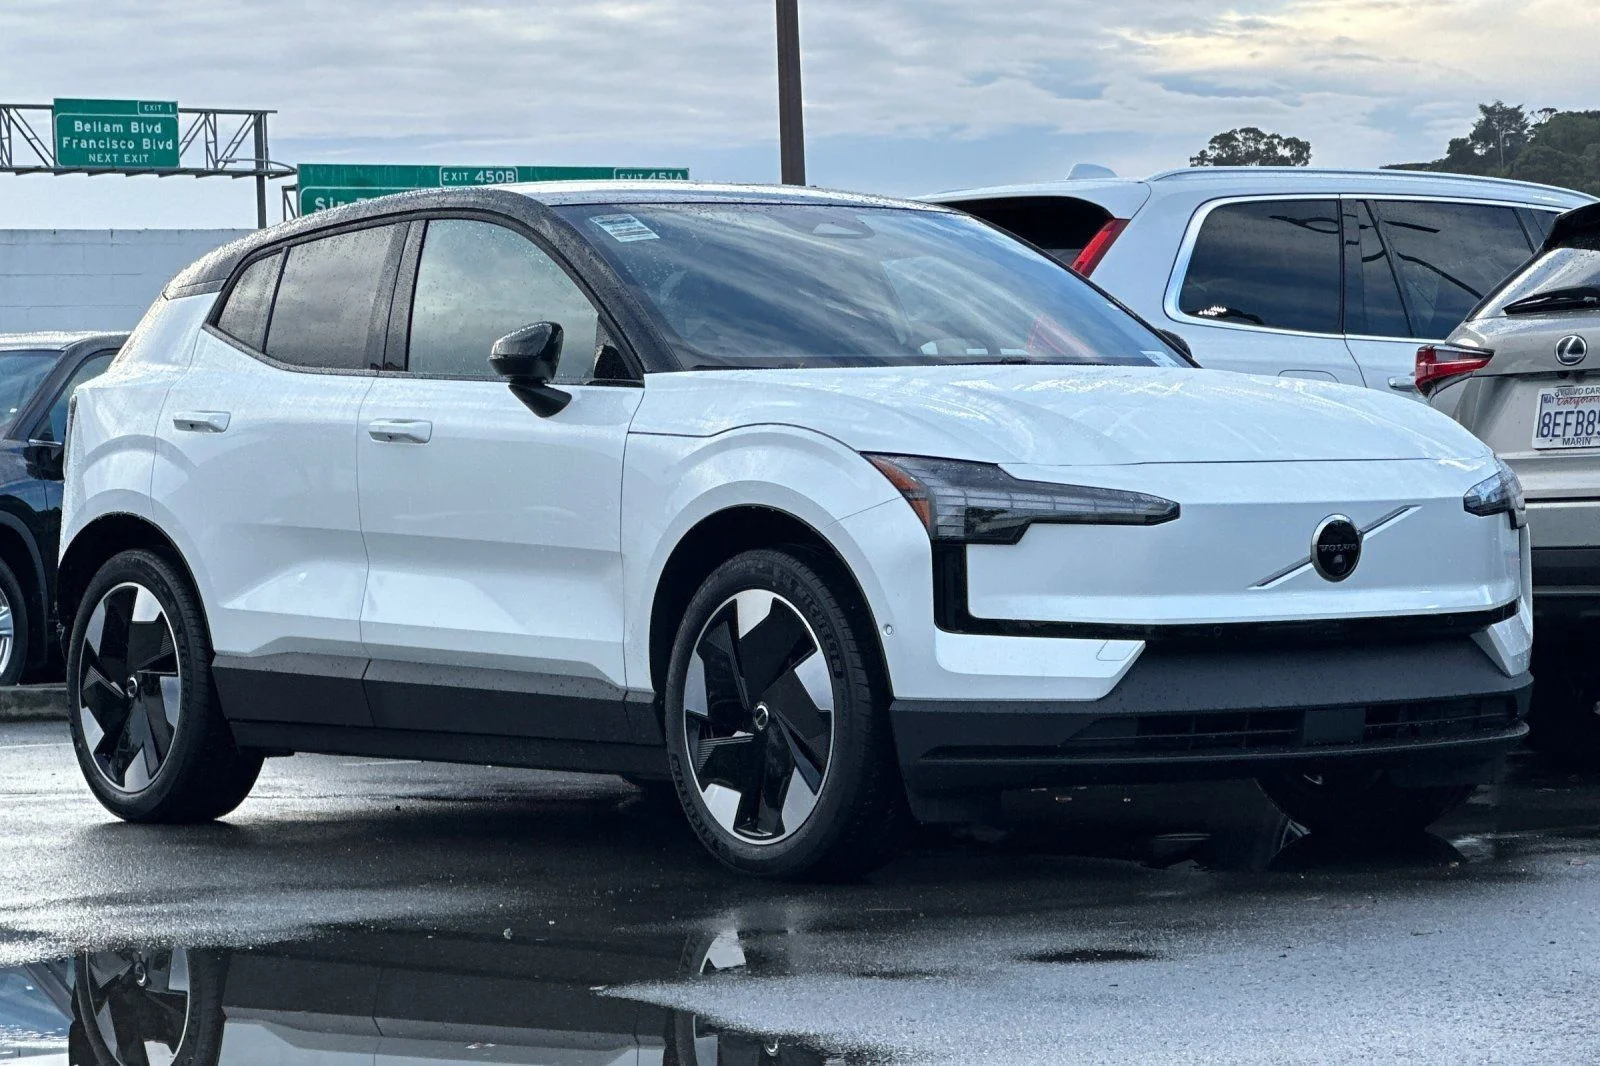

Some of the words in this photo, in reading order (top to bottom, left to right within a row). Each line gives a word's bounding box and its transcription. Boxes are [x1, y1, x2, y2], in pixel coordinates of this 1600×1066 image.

[169, 104, 173, 112] 1
[74, 120, 123, 133] Bellam
[130, 121, 162, 134] Blvd
[62, 137, 134, 149] Francisco
[142, 138, 173, 150] Blvd
[88, 154, 118, 163] NEXT
[124, 154, 149, 163] EXIT
[443, 172, 468, 182] EXIT
[474, 170, 515, 183] 450B
[1541, 410, 1600, 437] 8EFB8
[1563, 437, 1591, 445] MARIN
